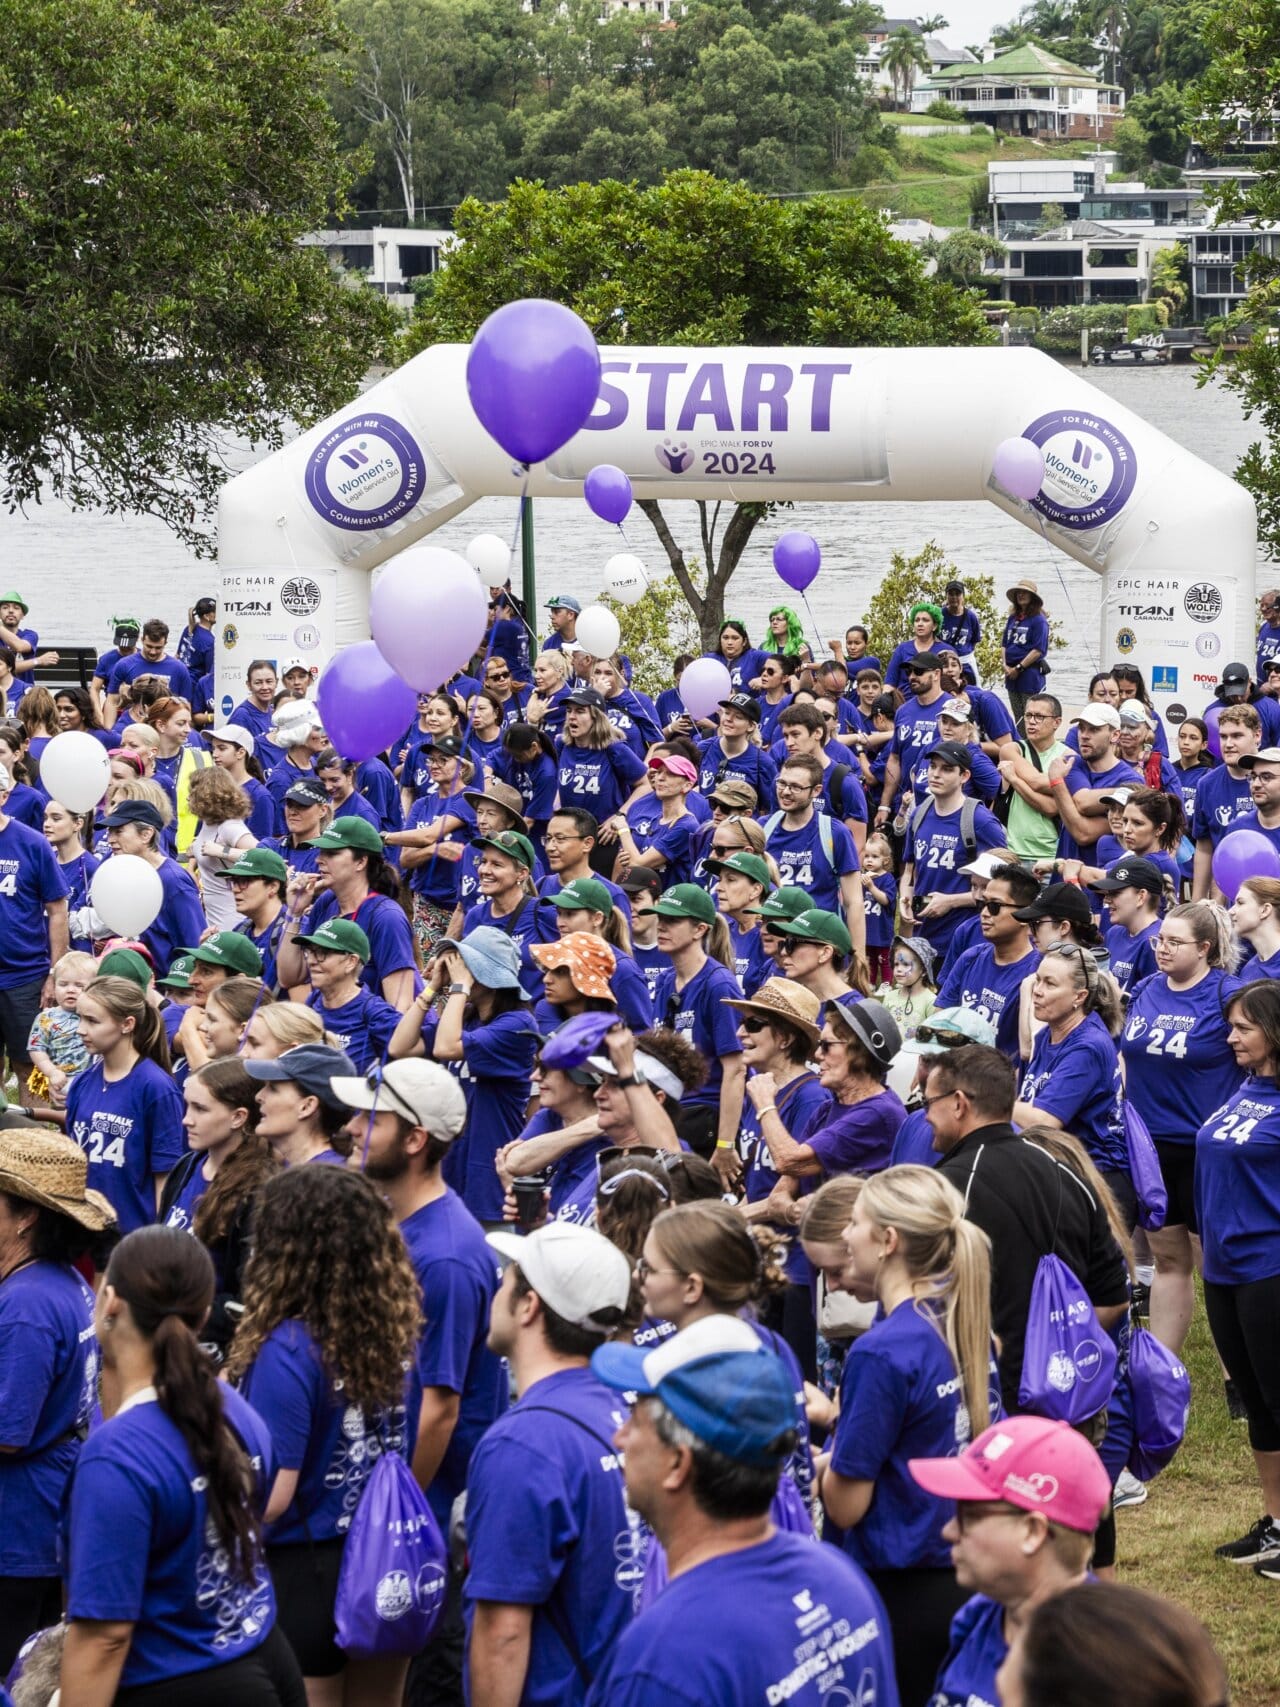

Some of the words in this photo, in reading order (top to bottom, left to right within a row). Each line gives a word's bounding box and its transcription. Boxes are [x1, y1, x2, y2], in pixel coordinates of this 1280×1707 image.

[580, 362, 852, 432] START
[700, 440, 718, 448] EPIC
[719, 440, 742, 448] WALK
[743, 440, 760, 448] FOR
[761, 440, 774, 448] DV
[702, 452, 777, 475] 2024
[337, 458, 394, 495] Women's
[408, 462, 418, 489] YEARS
[1045, 452, 1099, 494] Women's
[344, 490, 365, 504] Legal
[363, 475, 387, 493] Service
[1058, 476, 1080, 495] Service
[404, 490, 414, 501] 40
[329, 500, 406, 525] COMMEMORATING
[1081, 506, 1106, 522] YEARS
[223, 577, 241, 586] EPIC
[246, 577, 275, 585] HAIR
[1117, 580, 1141, 589] EPIC
[1147, 581, 1179, 590] HAIR
[223, 601, 272, 612] TITAN
[283, 597, 319, 606] WOLFF
[1186, 602, 1220, 612] WOLFF
[1118, 605, 1175, 616] TITAN
[1014, 633, 1027, 644] 24
[1193, 673, 1218, 683] nova
[912, 731, 934, 747] 24
[574, 777, 601, 795] 24
[1185, 801, 1195, 816] 4
[927, 849, 956, 870] 24
[780, 865, 814, 886] 24
[0, 875, 18, 896] 4
[865, 901, 882, 916] 24
[1152, 1022, 1173, 1030] FOR
[1175, 1023, 1194, 1031] DV
[1158, 1015, 1174, 1023] EPIC
[1147, 1029, 1187, 1059] 24
[1240, 1099, 1259, 1111] EPIC
[109, 1115, 134, 1128] WALK
[1213, 1114, 1259, 1145] 24
[111, 1124, 133, 1137] DV
[90, 1132, 127, 1168] 24
[828, 1618, 880, 1663] VIOLENCE
